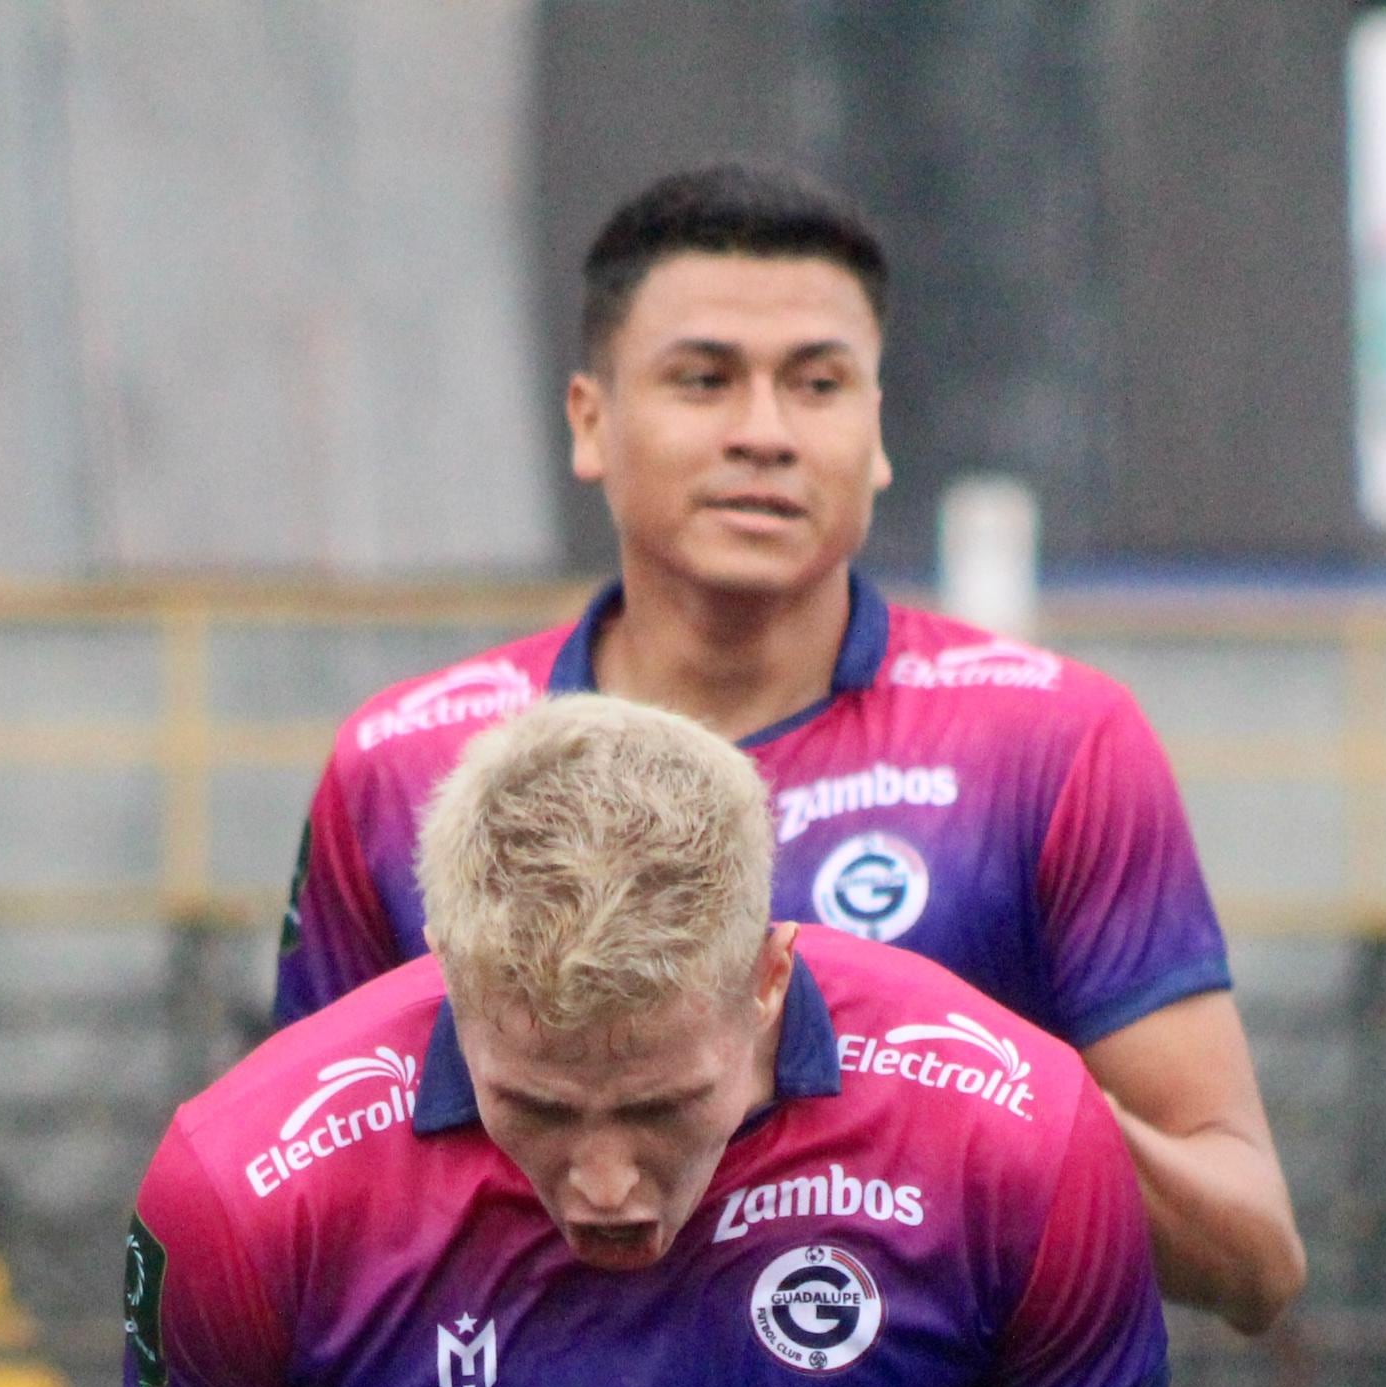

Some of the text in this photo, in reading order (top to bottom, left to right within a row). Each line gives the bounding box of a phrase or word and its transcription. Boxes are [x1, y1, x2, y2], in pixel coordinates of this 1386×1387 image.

[777, 763, 957, 843] Zambos
[837, 1034, 1034, 1118] Electrolit
[246, 1085, 416, 1197] Electroli
[713, 1164, 924, 1243] Zambos
[757, 1307, 802, 1362] FUTBOL CLUB
[771, 1292, 861, 1305] GUADALUPE
